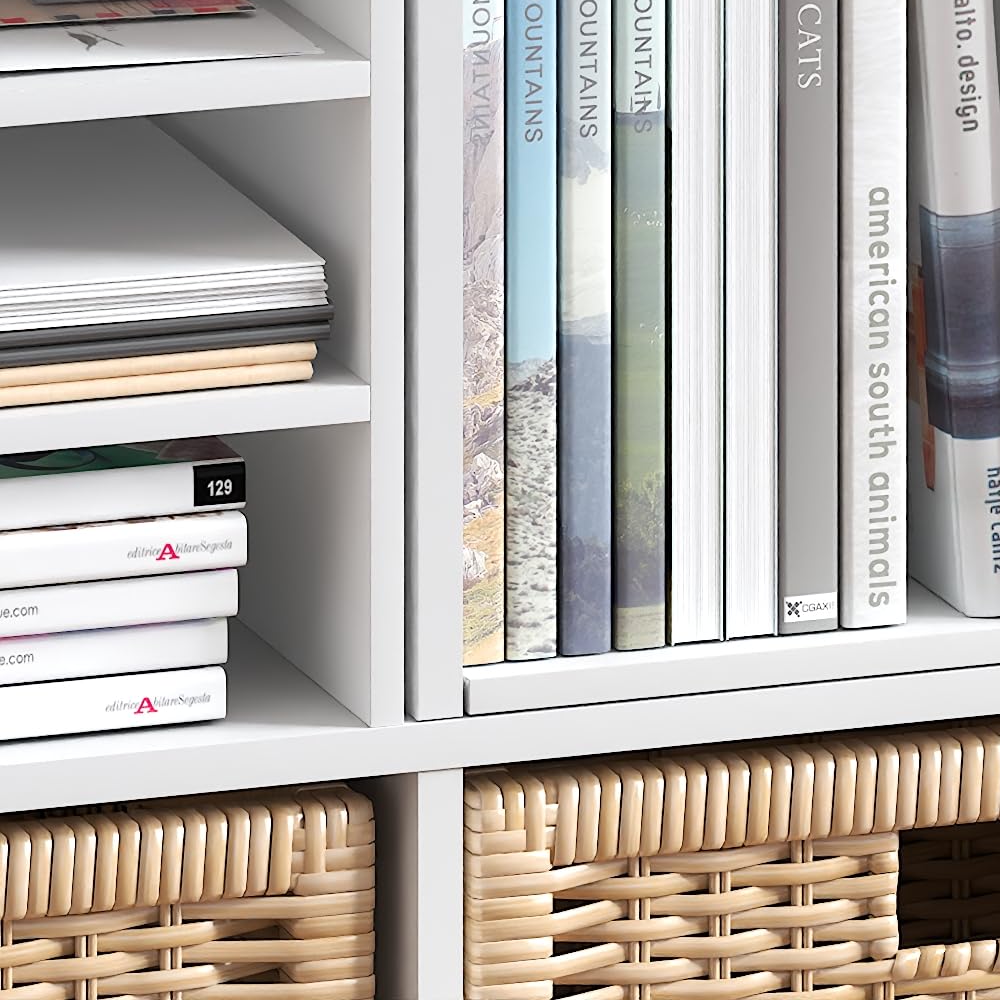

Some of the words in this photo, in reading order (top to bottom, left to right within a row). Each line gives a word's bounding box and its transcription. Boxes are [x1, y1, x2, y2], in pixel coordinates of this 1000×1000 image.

[797, 3, 822, 89] CATS
[955, 54, 983, 133] design
[868, 186, 897, 350] american
[868, 362, 897, 460] south
[207, 478, 233, 498] 129
[868, 471, 897, 609] animals
